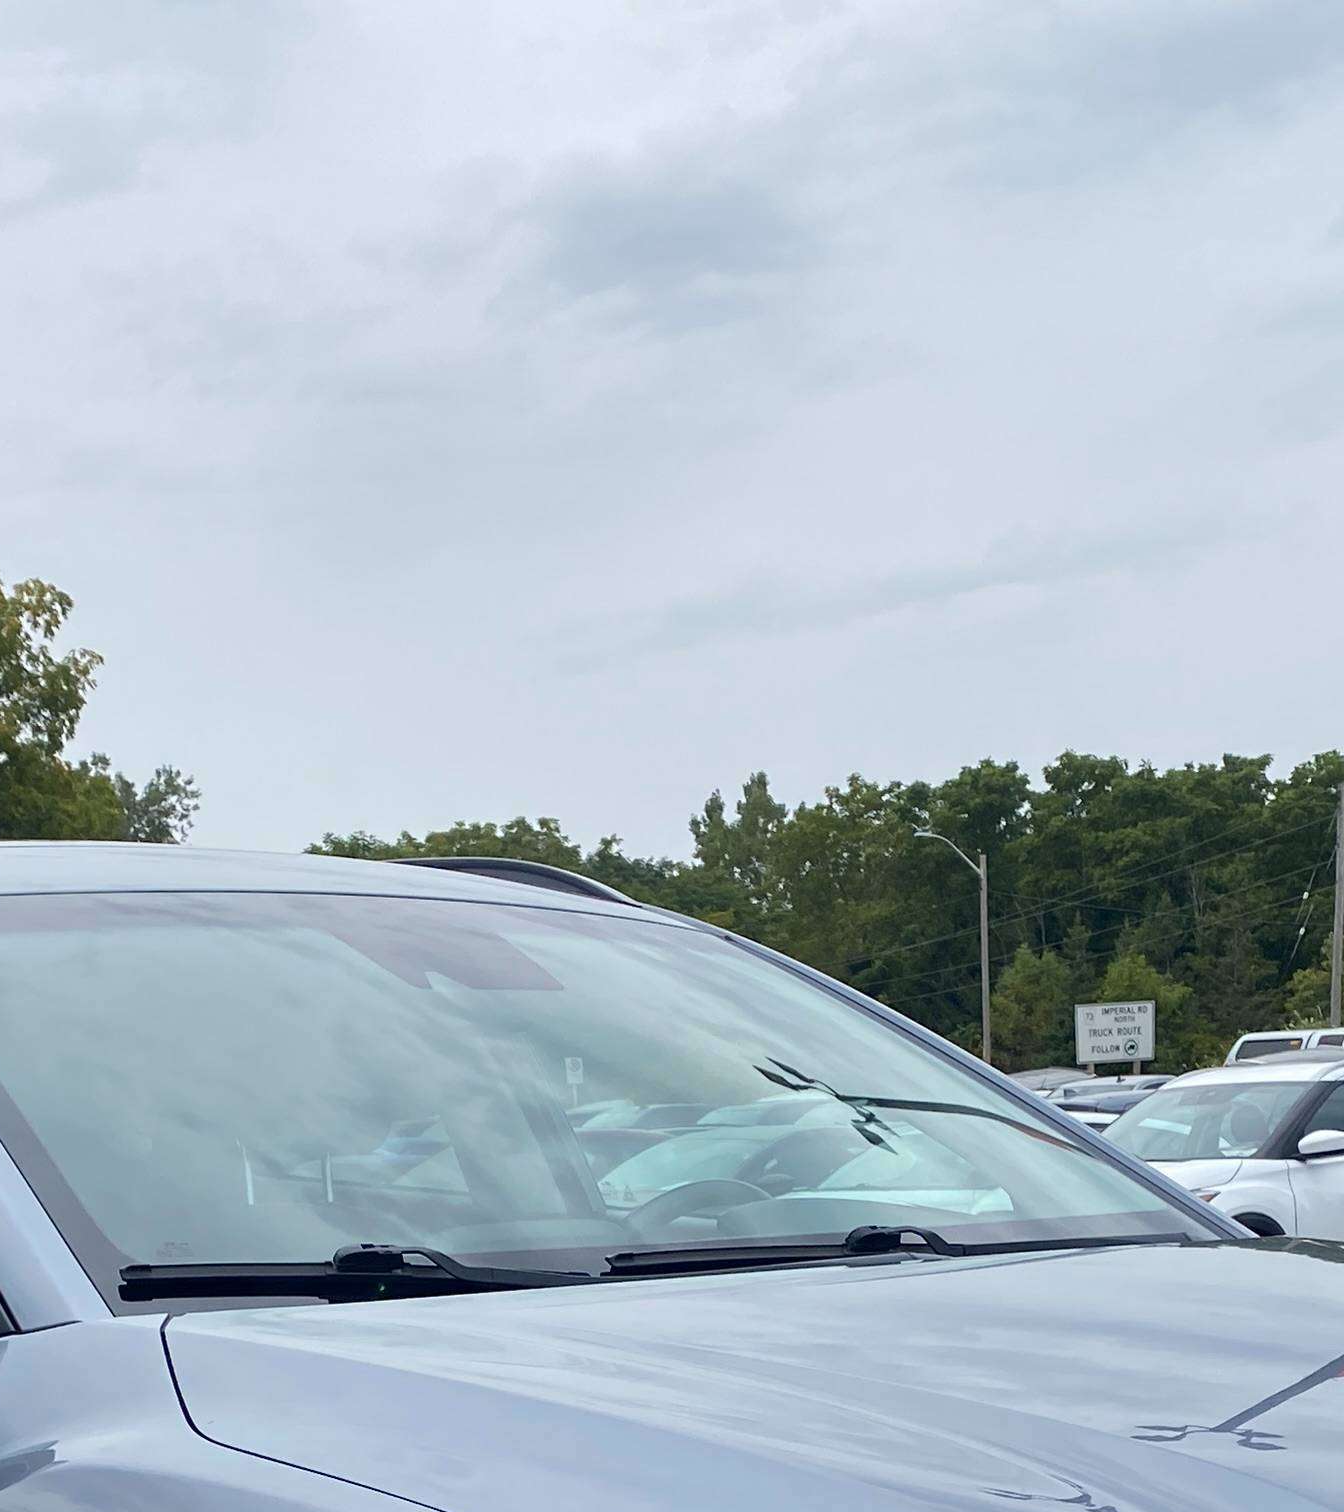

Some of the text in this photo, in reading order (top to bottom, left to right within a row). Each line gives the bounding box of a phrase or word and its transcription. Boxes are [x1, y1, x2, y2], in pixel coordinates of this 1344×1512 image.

[1102, 1005, 1148, 1016] IMPERIAL RD
[1088, 1026, 1142, 1038] TRUCK ROUTE
[1091, 1045, 1120, 1054] FOLLOW
